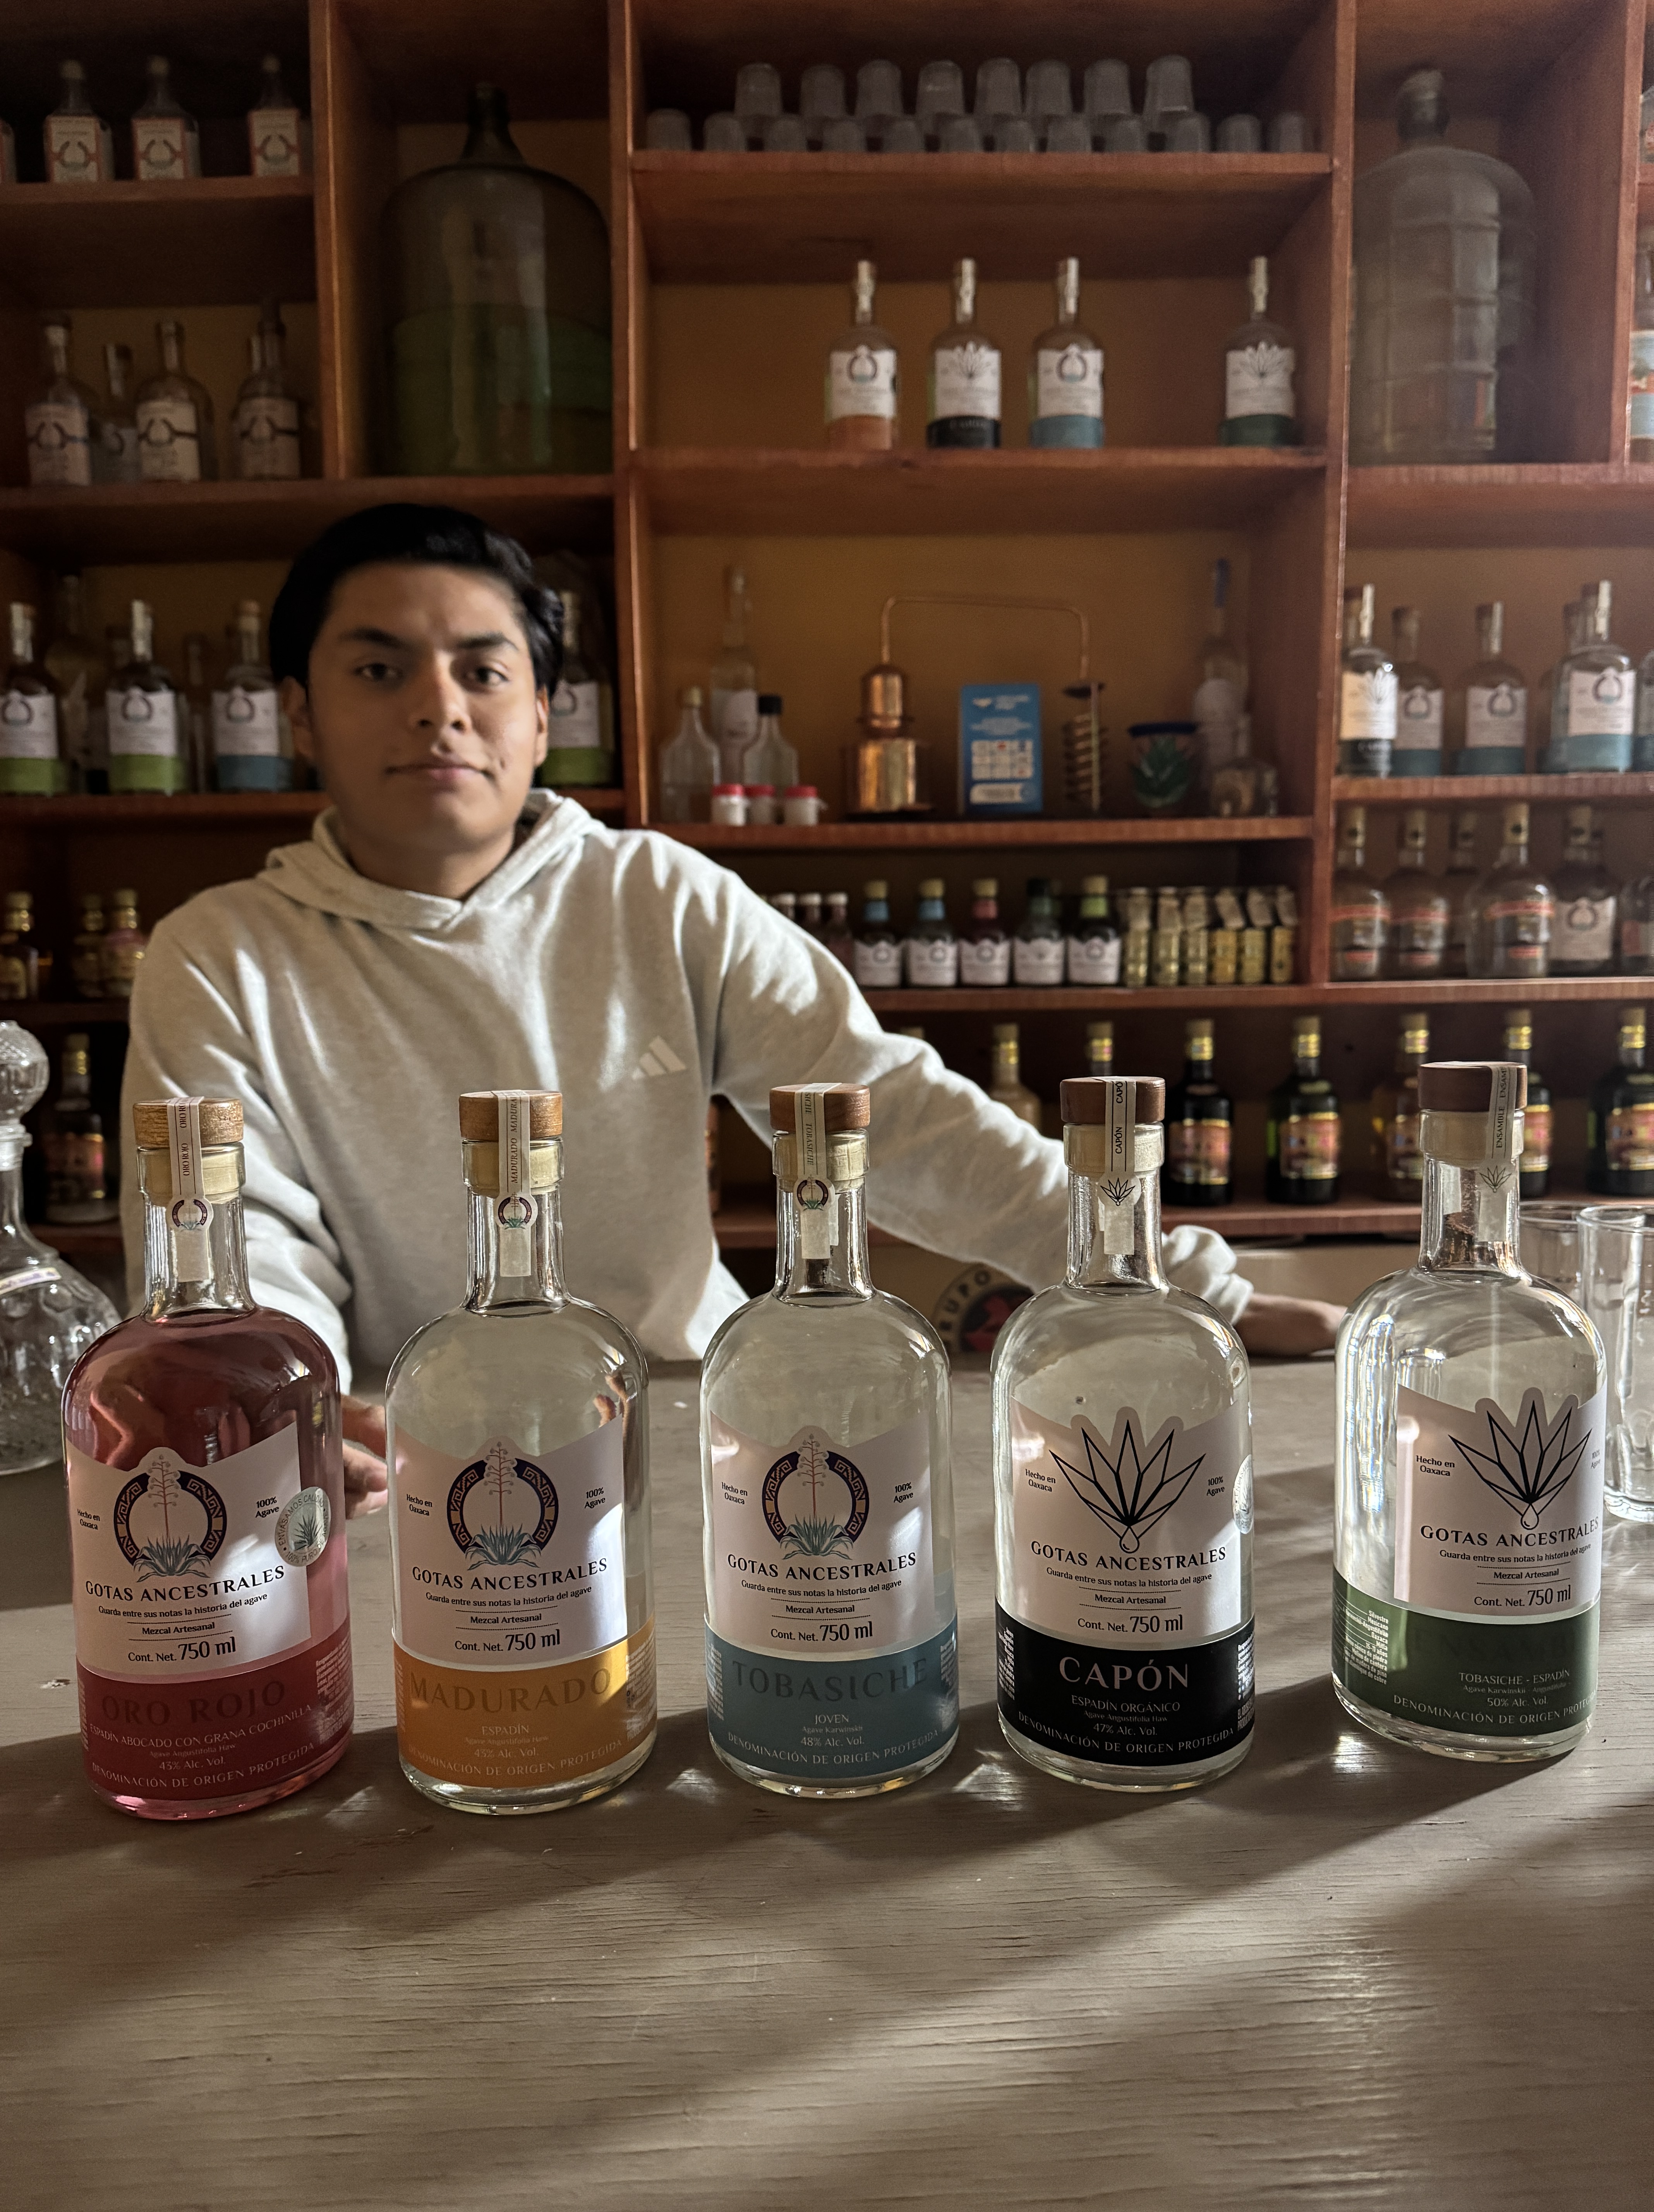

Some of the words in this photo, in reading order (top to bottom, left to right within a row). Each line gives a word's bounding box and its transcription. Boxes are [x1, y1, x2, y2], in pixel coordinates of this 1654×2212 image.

[1416, 1455, 1442, 1467] Hecho
[1026, 1469, 1045, 1481] Hecho
[1420, 1465, 1450, 1476] Oaxaca
[722, 1482, 738, 1494] Hecho
[895, 1482, 912, 1493] 100%
[1028, 1479, 1052, 1492] Oaxaca
[1208, 1476, 1223, 1486] 100%
[586, 1487, 604, 1498] 100%
[894, 1492, 913, 1503] Agave
[1206, 1486, 1225, 1496] Agave
[256, 1496, 277, 1508] 100%
[407, 1494, 423, 1505] Hecho
[585, 1497, 606, 1509] Agave
[724, 1492, 745, 1505] Oaxaca
[255, 1506, 280, 1518] Agave
[409, 1504, 429, 1516] Oaxaca
[80, 1519, 98, 1530] Oaxaca
[278, 1498, 303, 1546] ENVASAMOS
[1420, 1525, 1488, 1546] GOTAS
[1496, 1516, 1599, 1547] ANCESTRALES
[1031, 1541, 1088, 1566] GOTAS
[1096, 1547, 1226, 1571] ANCESTRALES
[1440, 1550, 1470, 1561] Guarda
[1473, 1554, 1495, 1562] entre
[1514, 1554, 1534, 1563] notas
[1545, 1551, 1569, 1560] historia
[728, 1554, 778, 1577] GOTAS
[786, 1553, 916, 1580] ANCESTRALES
[1525, 1568, 1559, 1579] Artesanal
[412, 1566, 463, 1589] GOTAS
[470, 1558, 607, 1590] ANCESTRALES
[1047, 1567, 1073, 1580] Guarda
[1075, 1574, 1096, 1584] entre
[1098, 1578, 1112, 1586] sus
[1114, 1578, 1137, 1587] notas
[1148, 1578, 1178, 1587] historia
[1180, 1577, 1191, 1585] del
[1193, 1573, 1212, 1583] agave
[86, 1581, 133, 1601] GOTAS
[141, 1566, 285, 1602] ANCESTRALES
[741, 1580, 765, 1592] Guarda
[767, 1587, 786, 1595] entre
[837, 1587, 866, 1595] historia
[868, 1584, 880, 1592] del
[882, 1579, 902, 1590] agave
[426, 1592, 450, 1603] Guarda
[451, 1598, 471, 1606] entre
[523, 1595, 554, 1605] historia
[557, 1592, 568, 1600] del
[570, 1585, 592, 1597] agave
[1095, 1594, 1124, 1603] Mezcal
[1126, 1596, 1166, 1604] Artesanal
[1474, 1597, 1502, 1606] Cont.
[1505, 1598, 1525, 1607] Net.
[1527, 1588, 1553, 1606] 750
[1557, 1584, 1571, 1602] ml
[99, 1606, 121, 1616] Guarda
[194, 1604, 227, 1614] historia
[230, 1599, 242, 1608] del
[244, 1593, 268, 1605] agave
[786, 1605, 813, 1613] Mezcal
[815, 1605, 855, 1614] Artesanal
[470, 1616, 499, 1624] Mezcal
[501, 1613, 542, 1624] Artesanal
[1078, 1618, 1104, 1630] Cont.
[1108, 1622, 1128, 1632] Net.
[1130, 1616, 1160, 1632] 750
[1165, 1614, 1183, 1632] ml
[173, 1622, 215, 1633] Artesanal
[771, 1628, 796, 1640] Cont.
[799, 1632, 818, 1641] Net.
[819, 1624, 849, 1641] 750
[854, 1621, 873, 1639] ml
[455, 1640, 480, 1651] Cont.
[483, 1642, 503, 1652] Net.
[505, 1632, 536, 1651] 750
[540, 1629, 560, 1647] ml
[128, 1652, 153, 1661] Cont.
[156, 1653, 177, 1661] Net.
[178, 1641, 210, 1661] 750
[216, 1637, 236, 1655] ml
[732, 1658, 926, 1702] TOBASICHE
[1059, 1657, 1188, 1691] CAPÓN
[1459, 1672, 1523, 1685] TOBASICHE
[1533, 1668, 1570, 1684] ESPADÍN
[411, 1668, 611, 1713] MADURADO
[103, 1696, 170, 1725] ORO
[189, 1681, 285, 1724] ROJO
[1072, 1695, 1117, 1712] ESPADÍN
[1121, 1702, 1180, 1712] ORGÁNICO
[1394, 1695, 1493, 1723] DENOMINACIÓN
[1500, 1715, 1515, 1723] DE
[1520, 1711, 1560, 1723] ORIGEN
[1487, 1697, 1508, 1706] 50%
[1512, 1698, 1529, 1707] Alc.
[122, 1736, 172, 1747] ABOCADO
[175, 1737, 200, 1747] CON
[204, 1729, 246, 1744] GRANA
[249, 1705, 311, 1735] COCHINILLA
[815, 1714, 849, 1724] JOVEN
[1019, 1711, 1099, 1749] DENOMINACIÓN
[1105, 1741, 1121, 1752] DE
[1126, 1743, 1173, 1753] ORIGEN
[1179, 1728, 1233, 1750] PROTEGIDA
[1093, 1723, 1114, 1734] 47%
[1117, 1726, 1135, 1735] Alc.
[1139, 1727, 1157, 1735] Vol.
[728, 1732, 807, 1762] DENOMINACIÓN
[813, 1755, 828, 1764] DE
[834, 1752, 880, 1764] ORIGEN
[800, 1737, 822, 1747] 48%
[93, 1762, 166, 1787] DENOMINACIÓN
[172, 1778, 189, 1787] DE
[194, 1770, 244, 1786] ORIGEN
[249, 1743, 314, 1774] PROTEGIDA
[410, 1744, 481, 1774] DENOMINACIÓN
[486, 1767, 502, 1776] DE
[507, 1763, 555, 1774] ORIGEN
